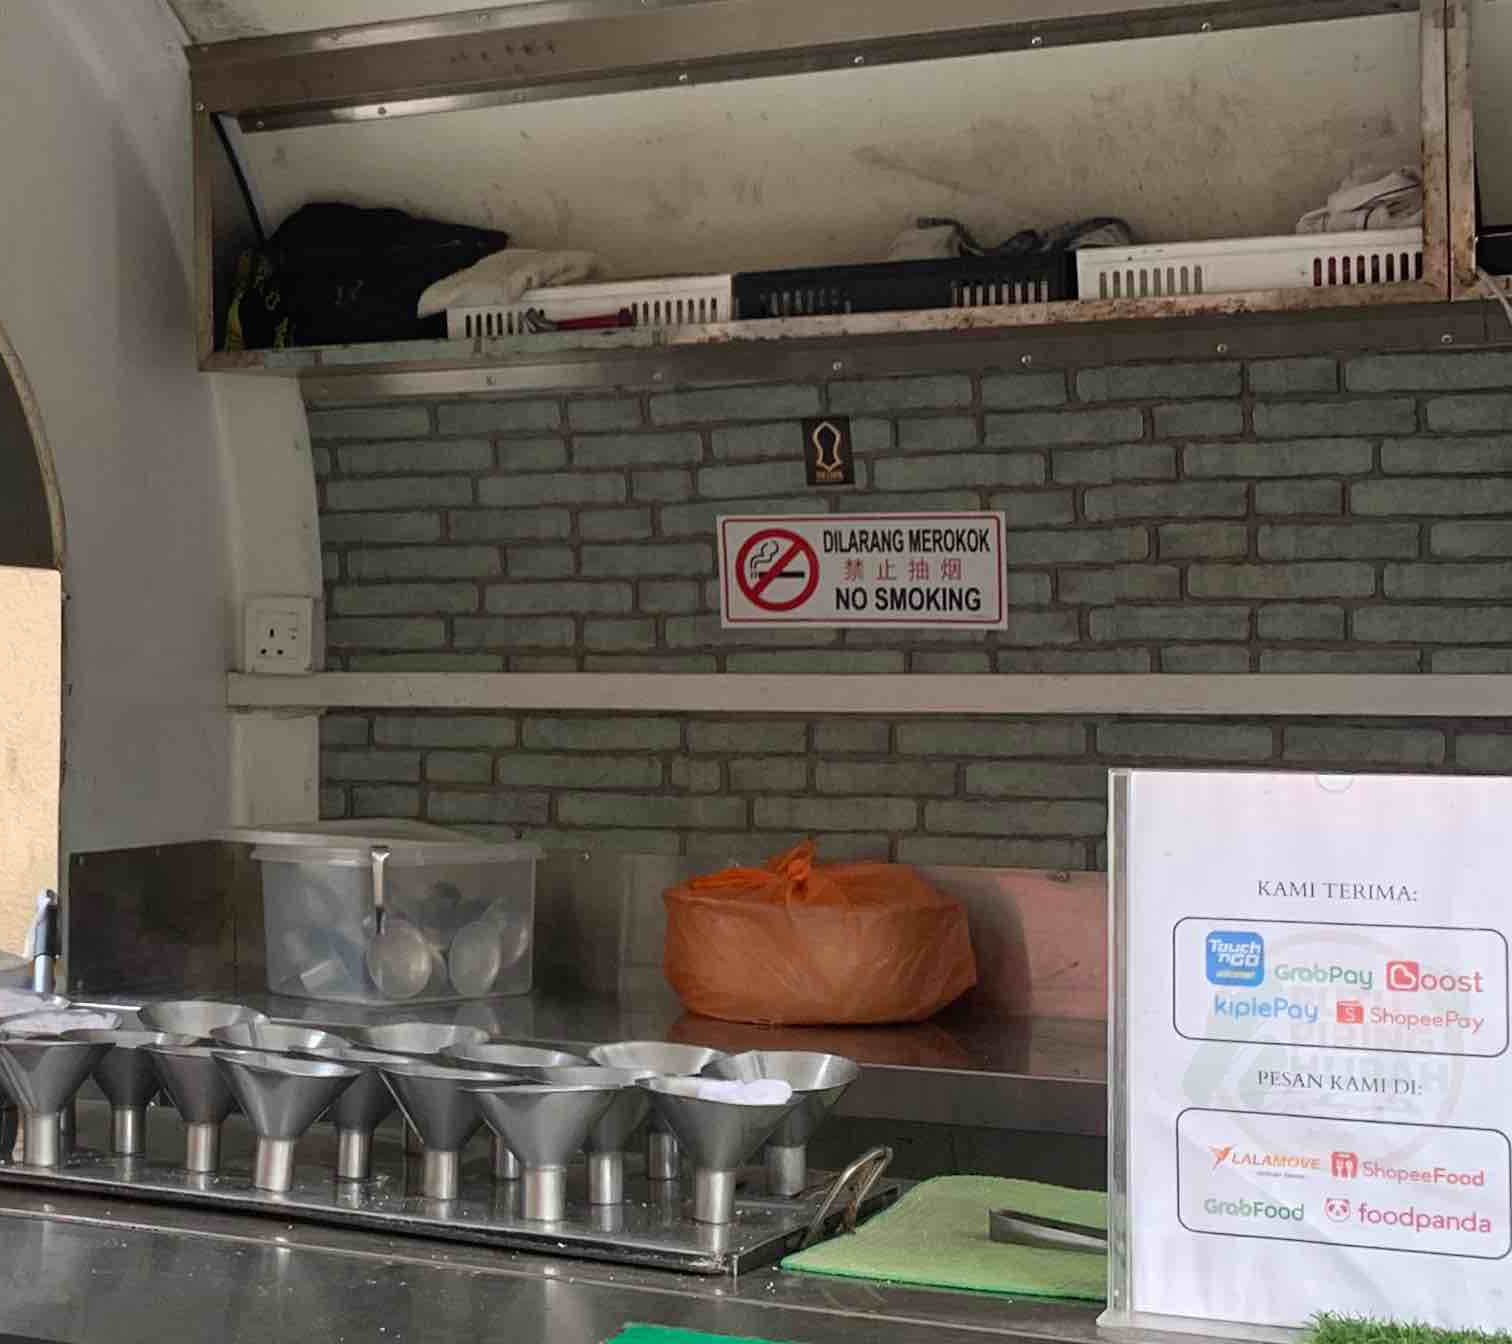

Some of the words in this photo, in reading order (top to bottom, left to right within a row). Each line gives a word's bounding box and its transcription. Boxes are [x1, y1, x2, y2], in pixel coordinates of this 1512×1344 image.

[823, 528, 904, 553] DILARANG
[909, 528, 991, 553] MEROKOK
[844, 557, 963, 582] 禁止抽烟
[835, 587, 868, 611] NO
[874, 587, 981, 612] SMOKING
[1258, 879, 1315, 898] KAMI
[1321, 882, 1419, 902] TERIMA:
[1209, 938, 1262, 955] Touch
[1274, 963, 1374, 991] GrabPay
[1214, 993, 1319, 1024] kiplePay
[1368, 1006, 1485, 1034] ShopeePay
[1257, 1070, 1323, 1089] PESAN
[1329, 1075, 1386, 1093] KAMI
[1393, 1078, 1424, 1096] DI:
[1232, 1152, 1320, 1170] LALAMOVE
[1361, 1160, 1486, 1187] ShopeeFood
[1203, 1197, 1305, 1221] GrabFood
[1358, 1202, 1492, 1233] foodpanda
